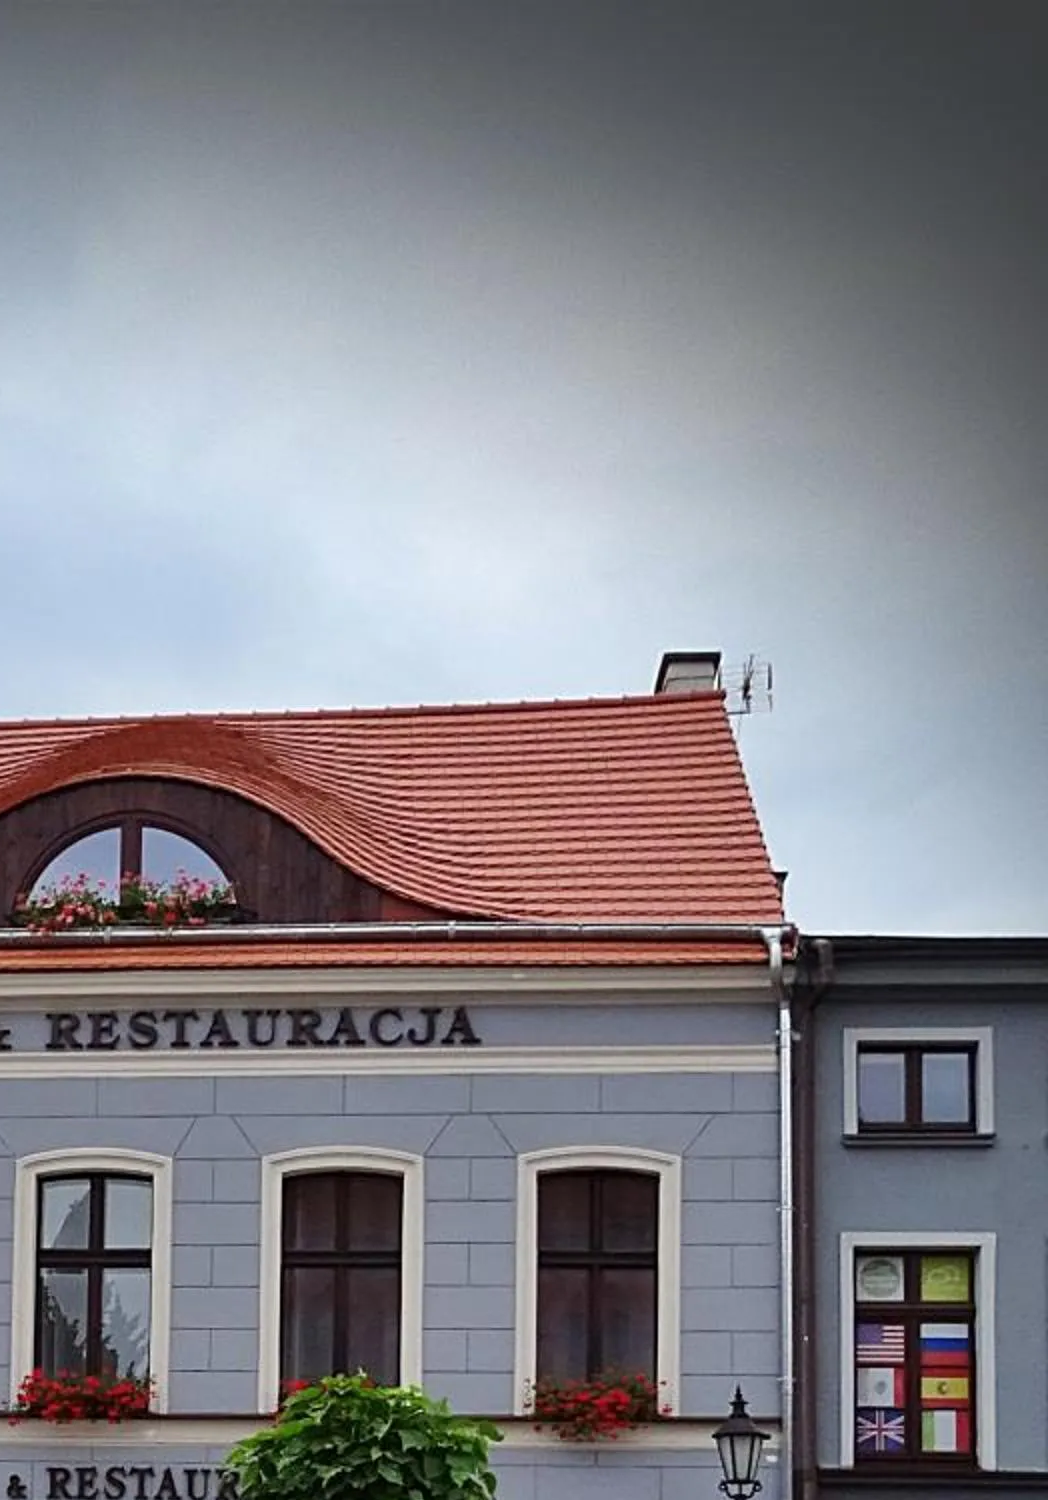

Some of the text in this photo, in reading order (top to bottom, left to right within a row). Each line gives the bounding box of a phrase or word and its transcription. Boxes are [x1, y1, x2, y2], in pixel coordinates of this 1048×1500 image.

[46, 1007, 482, 1049] RESTAURACJA
[6, 1474, 28, 1499] &
[46, 1466, 242, 1500] RESTAUR
